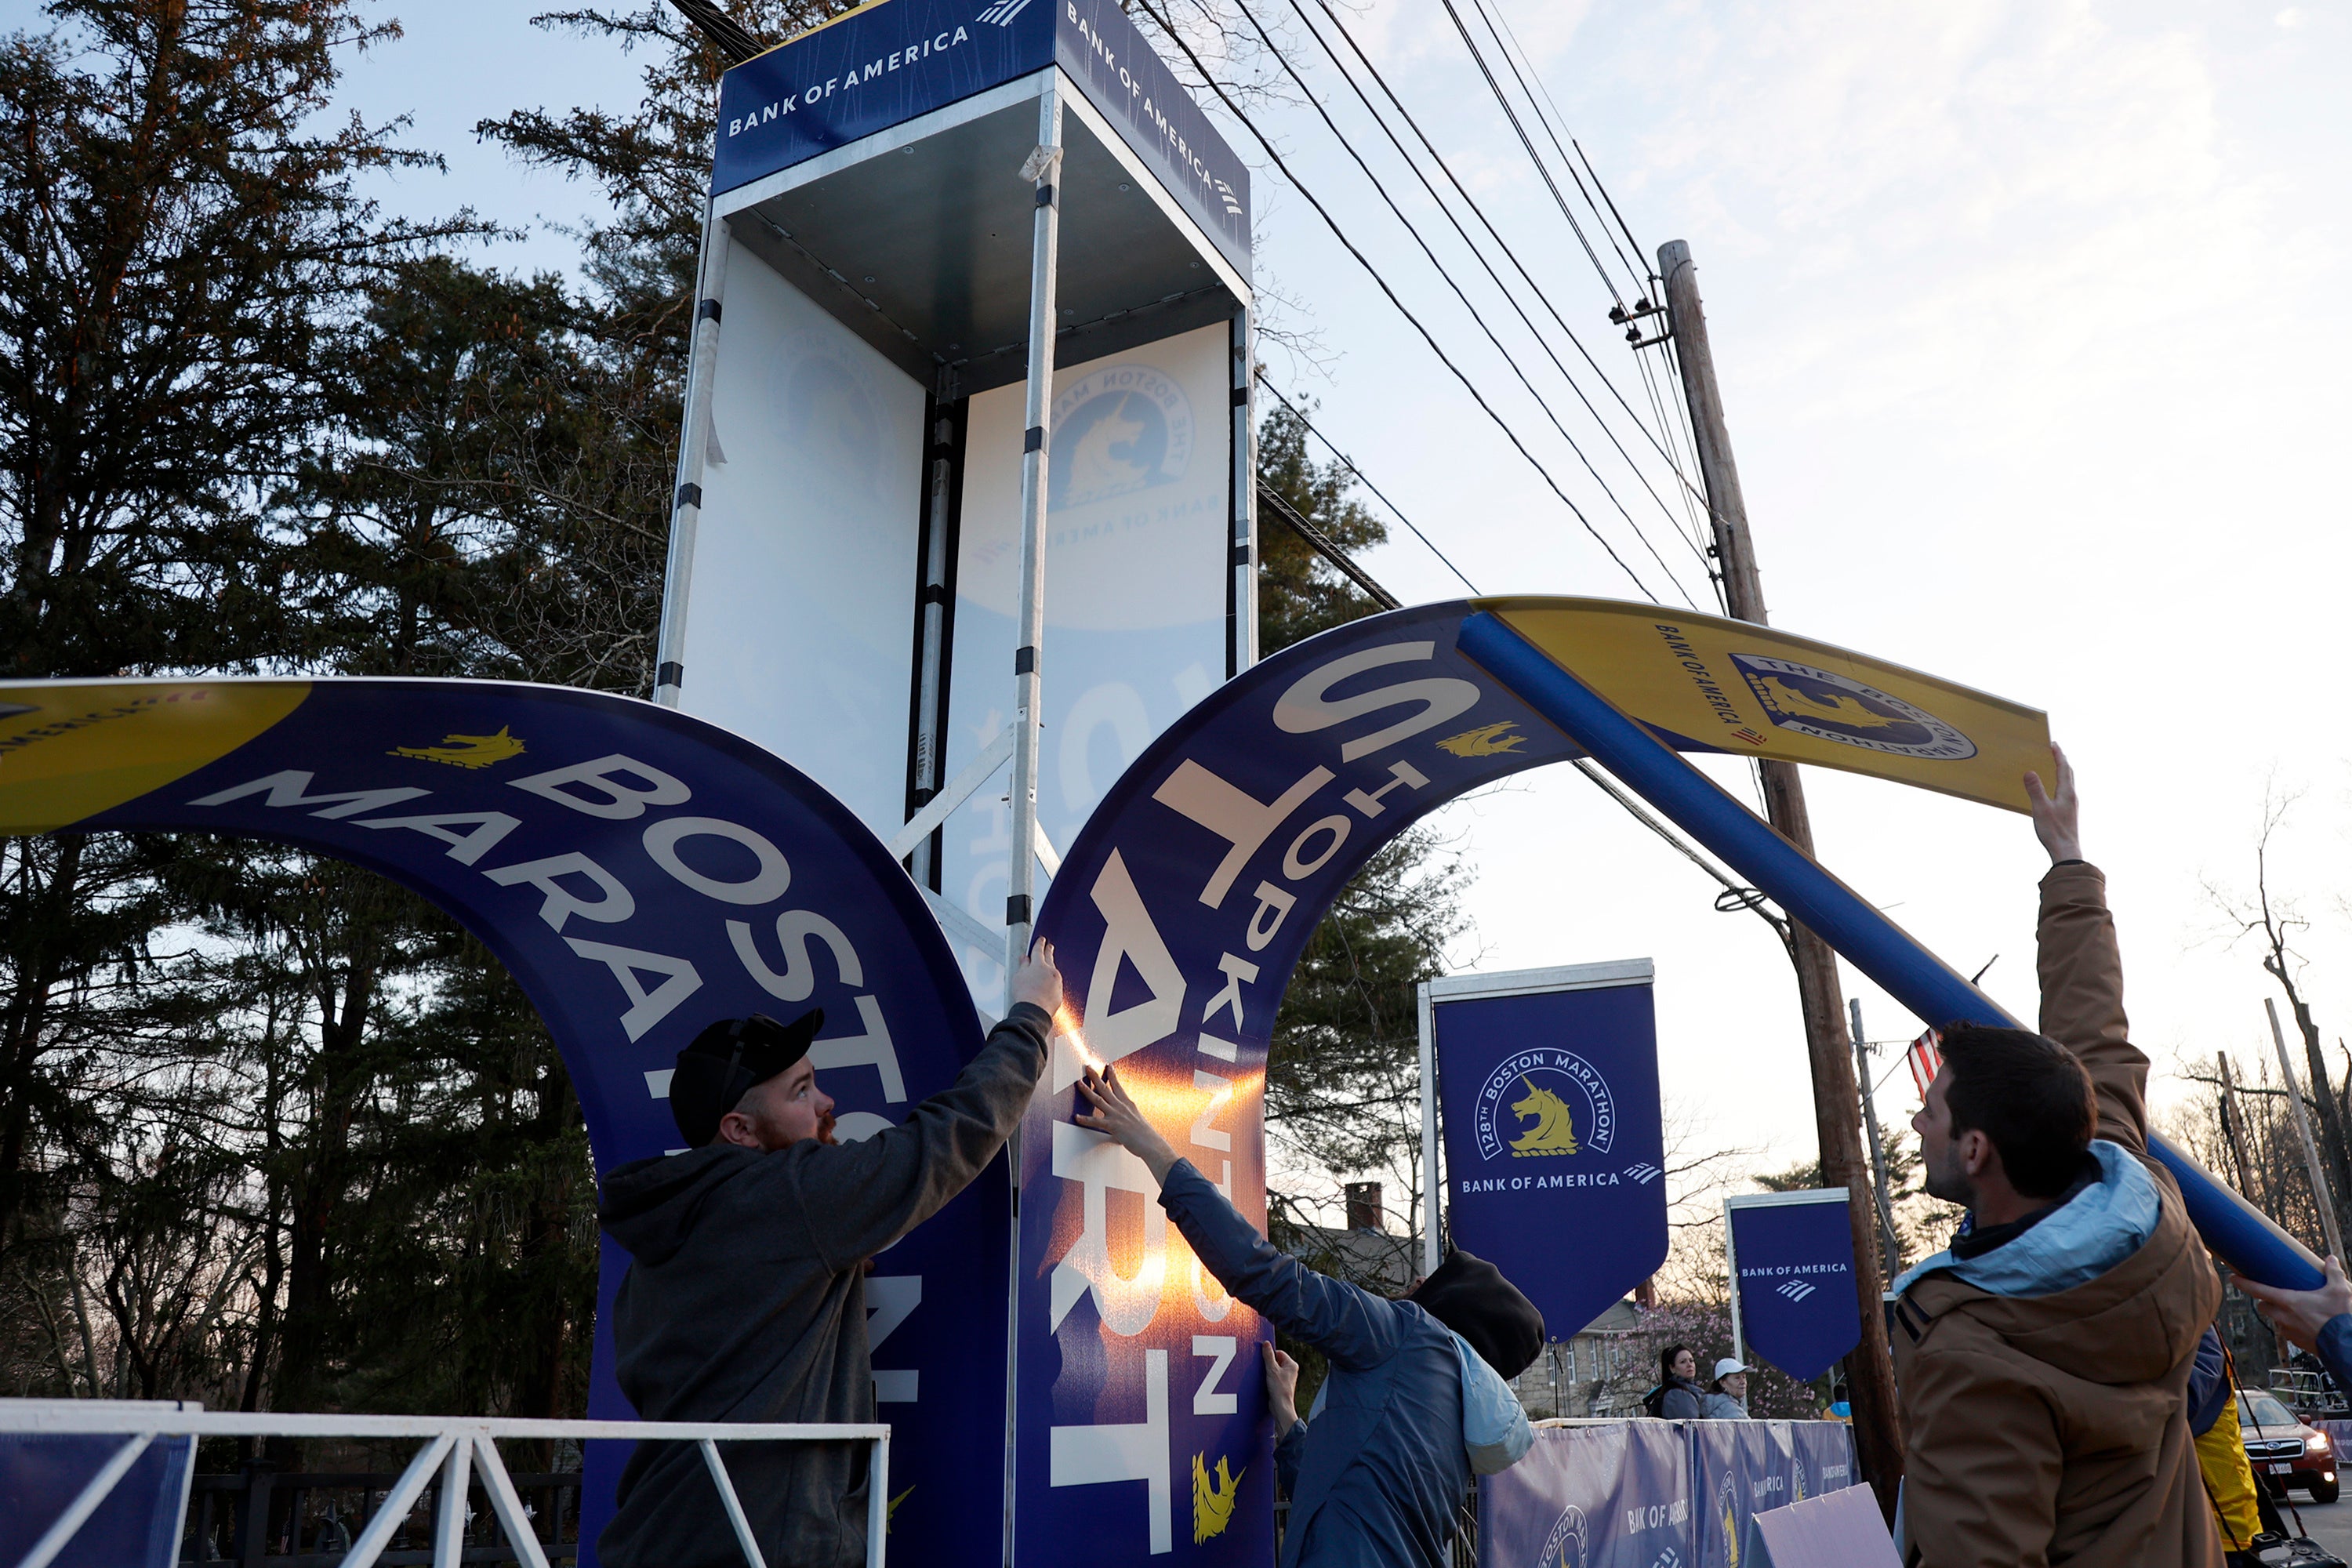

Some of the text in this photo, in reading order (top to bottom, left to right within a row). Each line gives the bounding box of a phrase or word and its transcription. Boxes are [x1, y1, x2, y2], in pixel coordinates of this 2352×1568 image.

[728, 25, 969, 137] BANK OF AMERICA
[1067, 0, 1212, 190] BANK OF AMERICA
[1655, 624, 1743, 724] BANK OF AMERICA
[1759, 659, 1964, 757] THE BOSTON MARATHON
[504, 753, 922, 1403] BOST
[1050, 641, 1481, 1555] START
[1479, 1052, 1610, 1152] 128TH BOSTON MARATHON
[1462, 1173, 1620, 1193] BANK OF AMERICA
[1742, 1263, 1848, 1277] BANK OF AMERICA
[1576, 1515, 1587, 1568] MARA
[1649, 1504, 1667, 1529] OF
